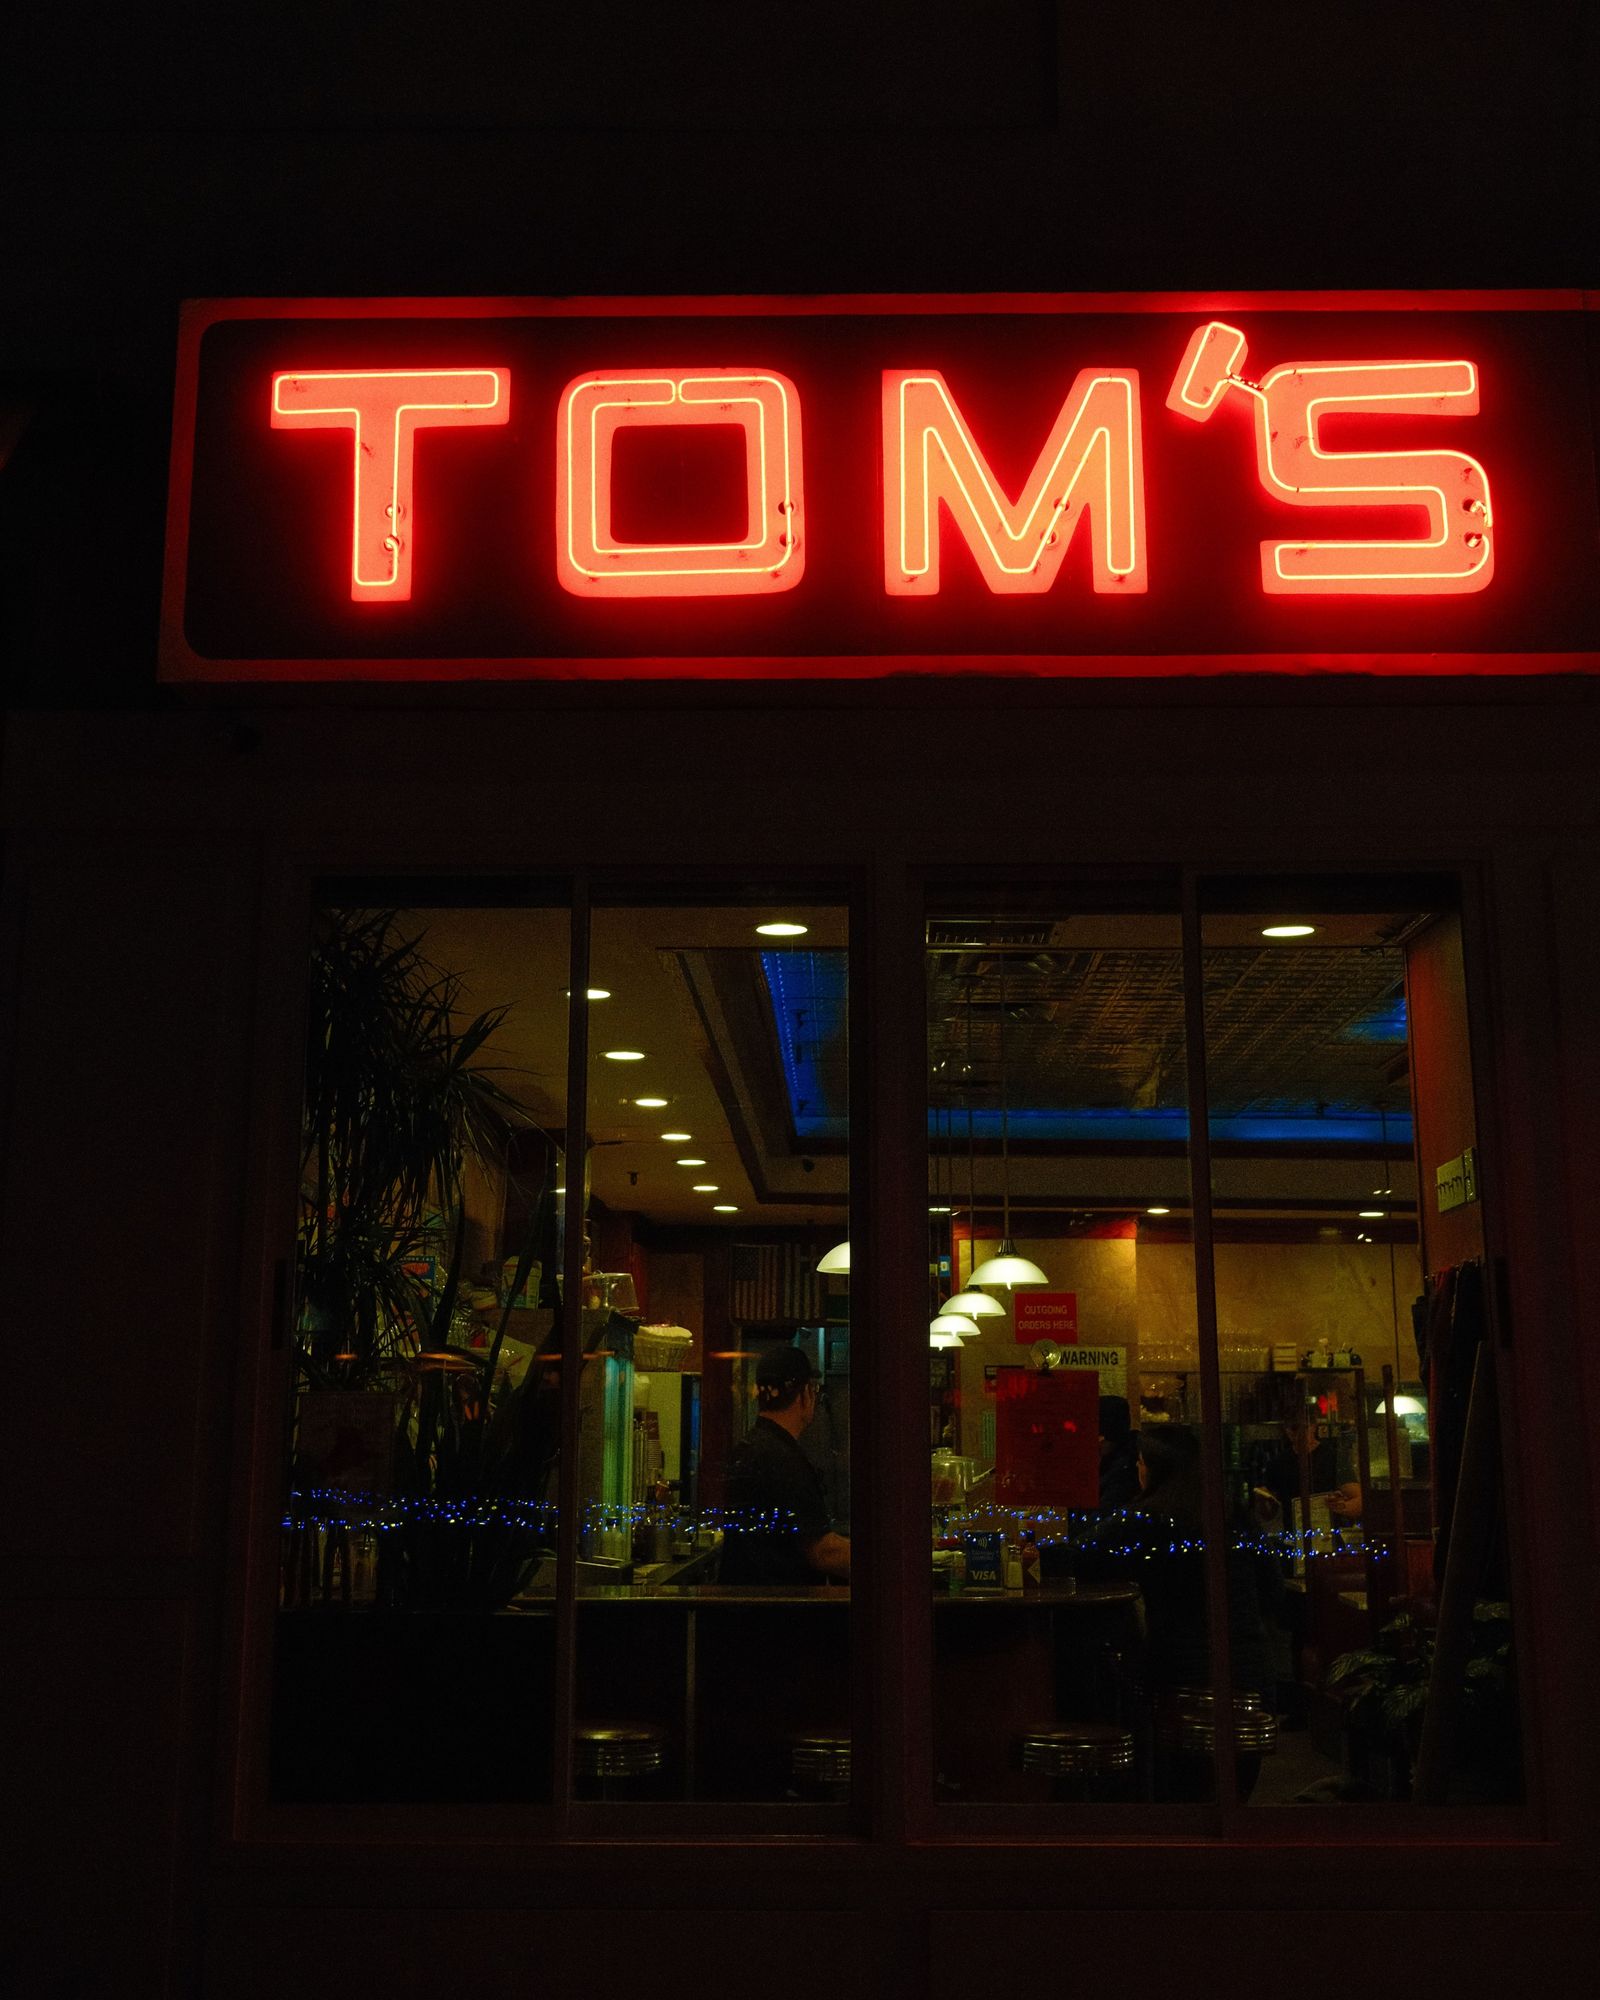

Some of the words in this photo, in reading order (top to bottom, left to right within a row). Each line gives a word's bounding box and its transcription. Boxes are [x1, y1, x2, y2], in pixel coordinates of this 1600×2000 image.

[270, 321, 1496, 602] TOM'S
[1024, 1304, 1067, 1315] OUTGOING
[1018, 1320, 1051, 1330] ORDERS
[1053, 1320, 1075, 1330] HERE
[1060, 1351, 1118, 1366] WARNING
[970, 1570, 997, 1581] VISA
